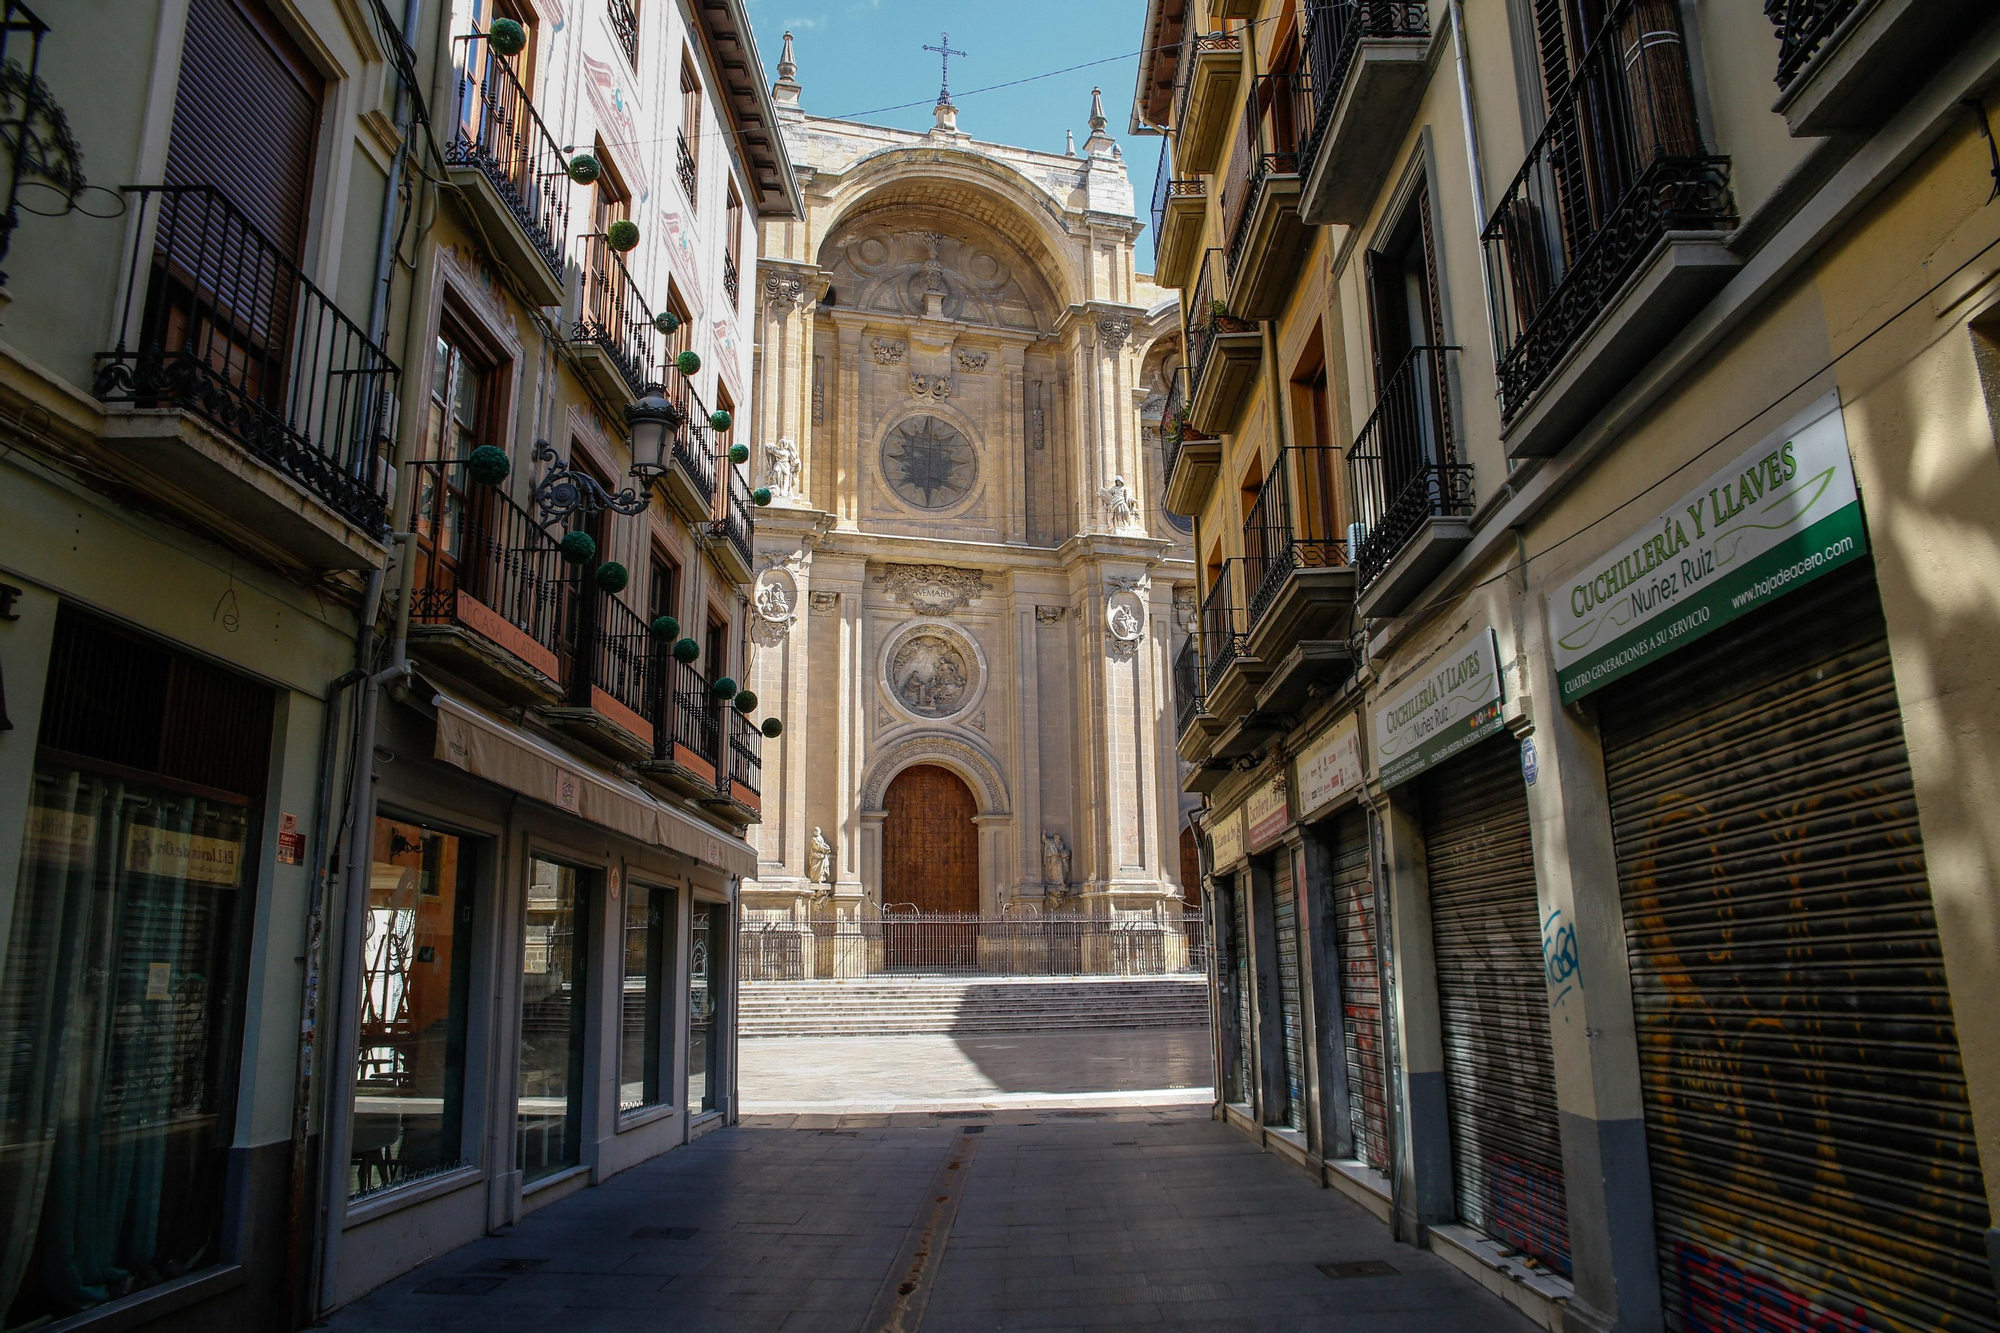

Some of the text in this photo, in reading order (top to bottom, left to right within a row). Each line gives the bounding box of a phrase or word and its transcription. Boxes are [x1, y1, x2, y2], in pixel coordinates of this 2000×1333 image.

[1571, 440, 1797, 618] CUCHILLERÍA Y LLAVES
[1631, 549, 1715, 618] Nuñez Ruiz
[1732, 535, 1854, 609] www.hojadeacero.com
[473, 607, 557, 678] CASA CATEDRAL
[1564, 606, 1710, 694] CUATRO GENERACIONES A SU SERVICIO
[1387, 650, 1480, 733] CUCHILLERÍA Y LLAVES
[1435, 704, 1450, 726] Ruiz
